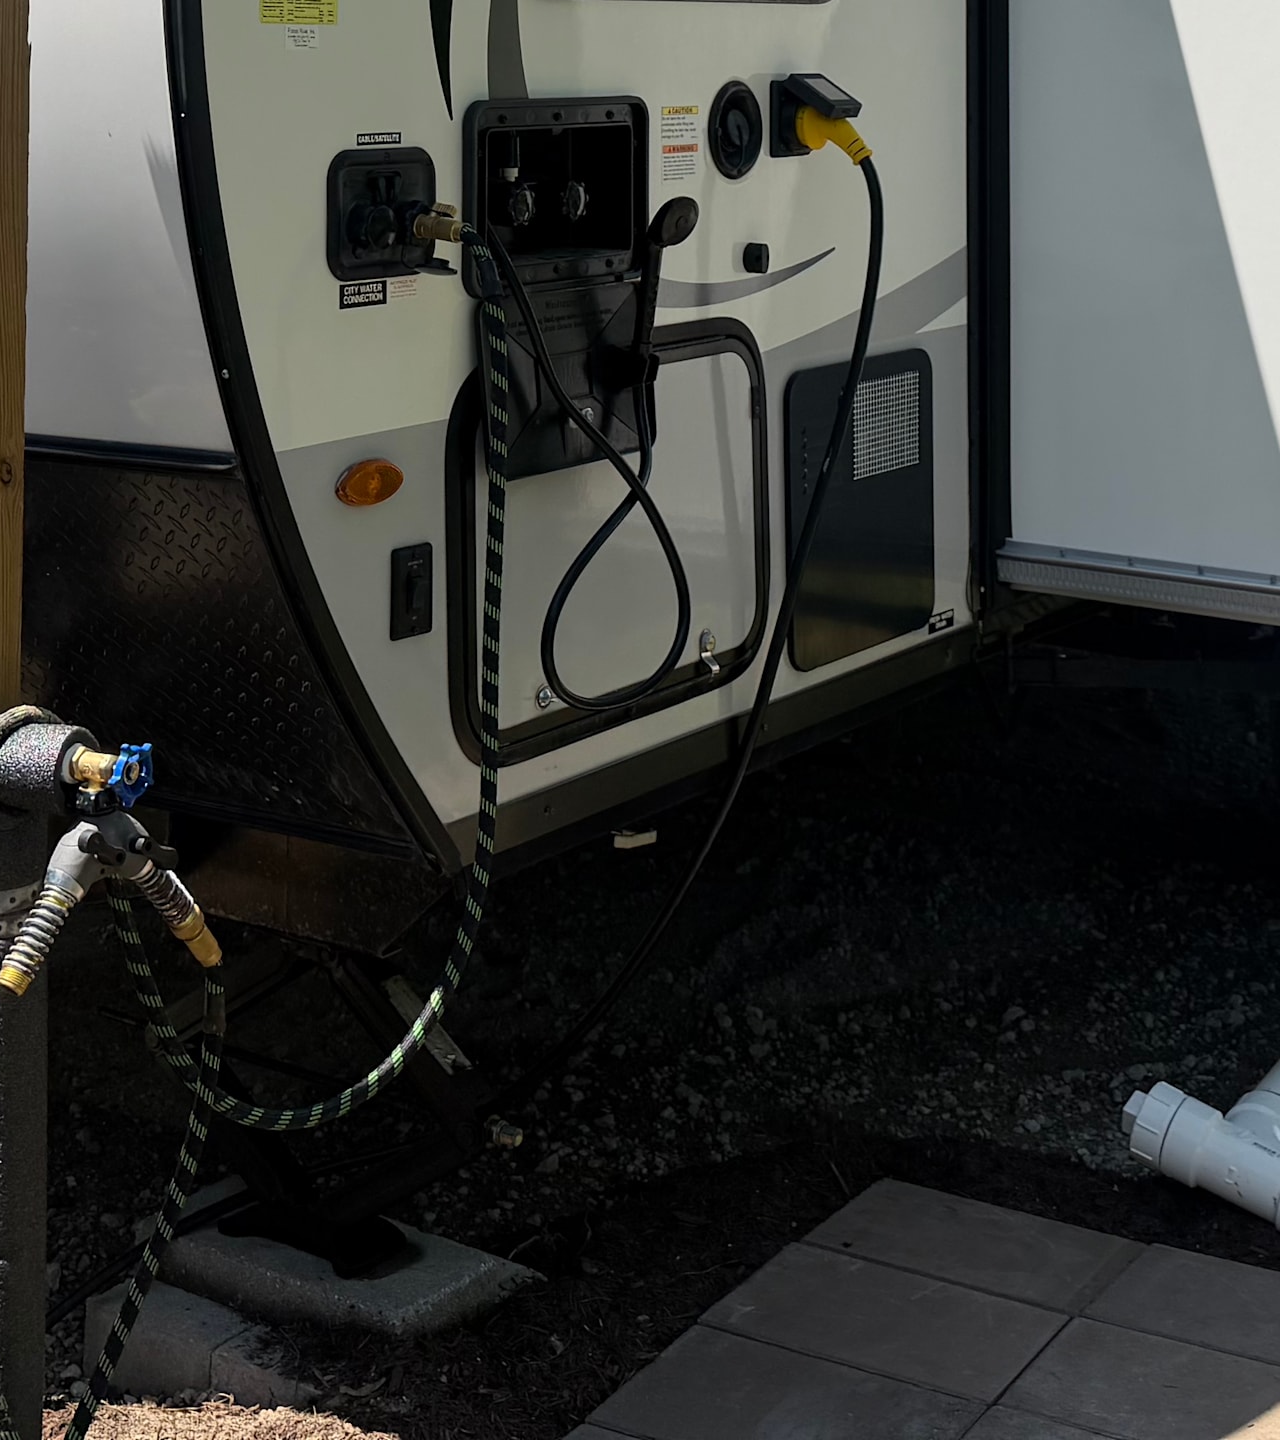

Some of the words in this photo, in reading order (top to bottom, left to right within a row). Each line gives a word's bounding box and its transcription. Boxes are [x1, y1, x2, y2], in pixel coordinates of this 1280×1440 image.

[343, 286, 359, 295] CITY
[360, 283, 382, 294] WATER
[343, 292, 383, 305] CONNECTION
